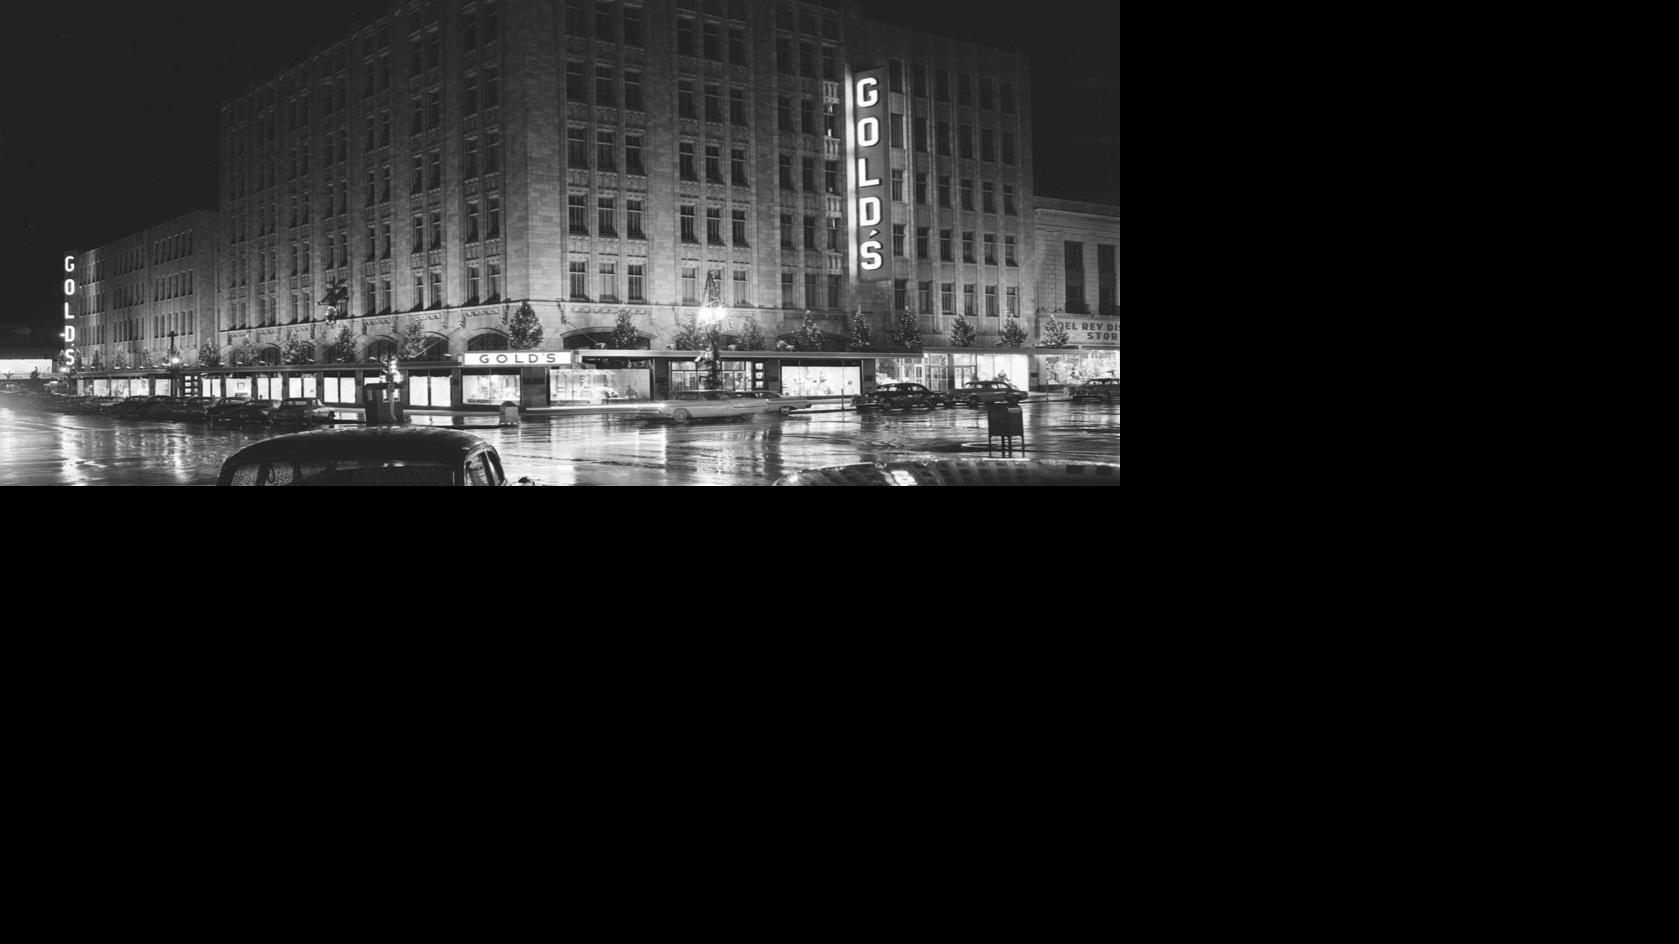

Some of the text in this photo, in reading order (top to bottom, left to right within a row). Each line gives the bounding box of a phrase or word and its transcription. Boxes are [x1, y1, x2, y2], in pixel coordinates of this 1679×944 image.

[856, 77, 882, 270] GOLD'S
[64, 255, 75, 366] GOLD'S
[1081, 322, 1104, 331] REY
[1107, 323, 1120, 332] DI
[479, 353, 556, 364] GOLD'S
